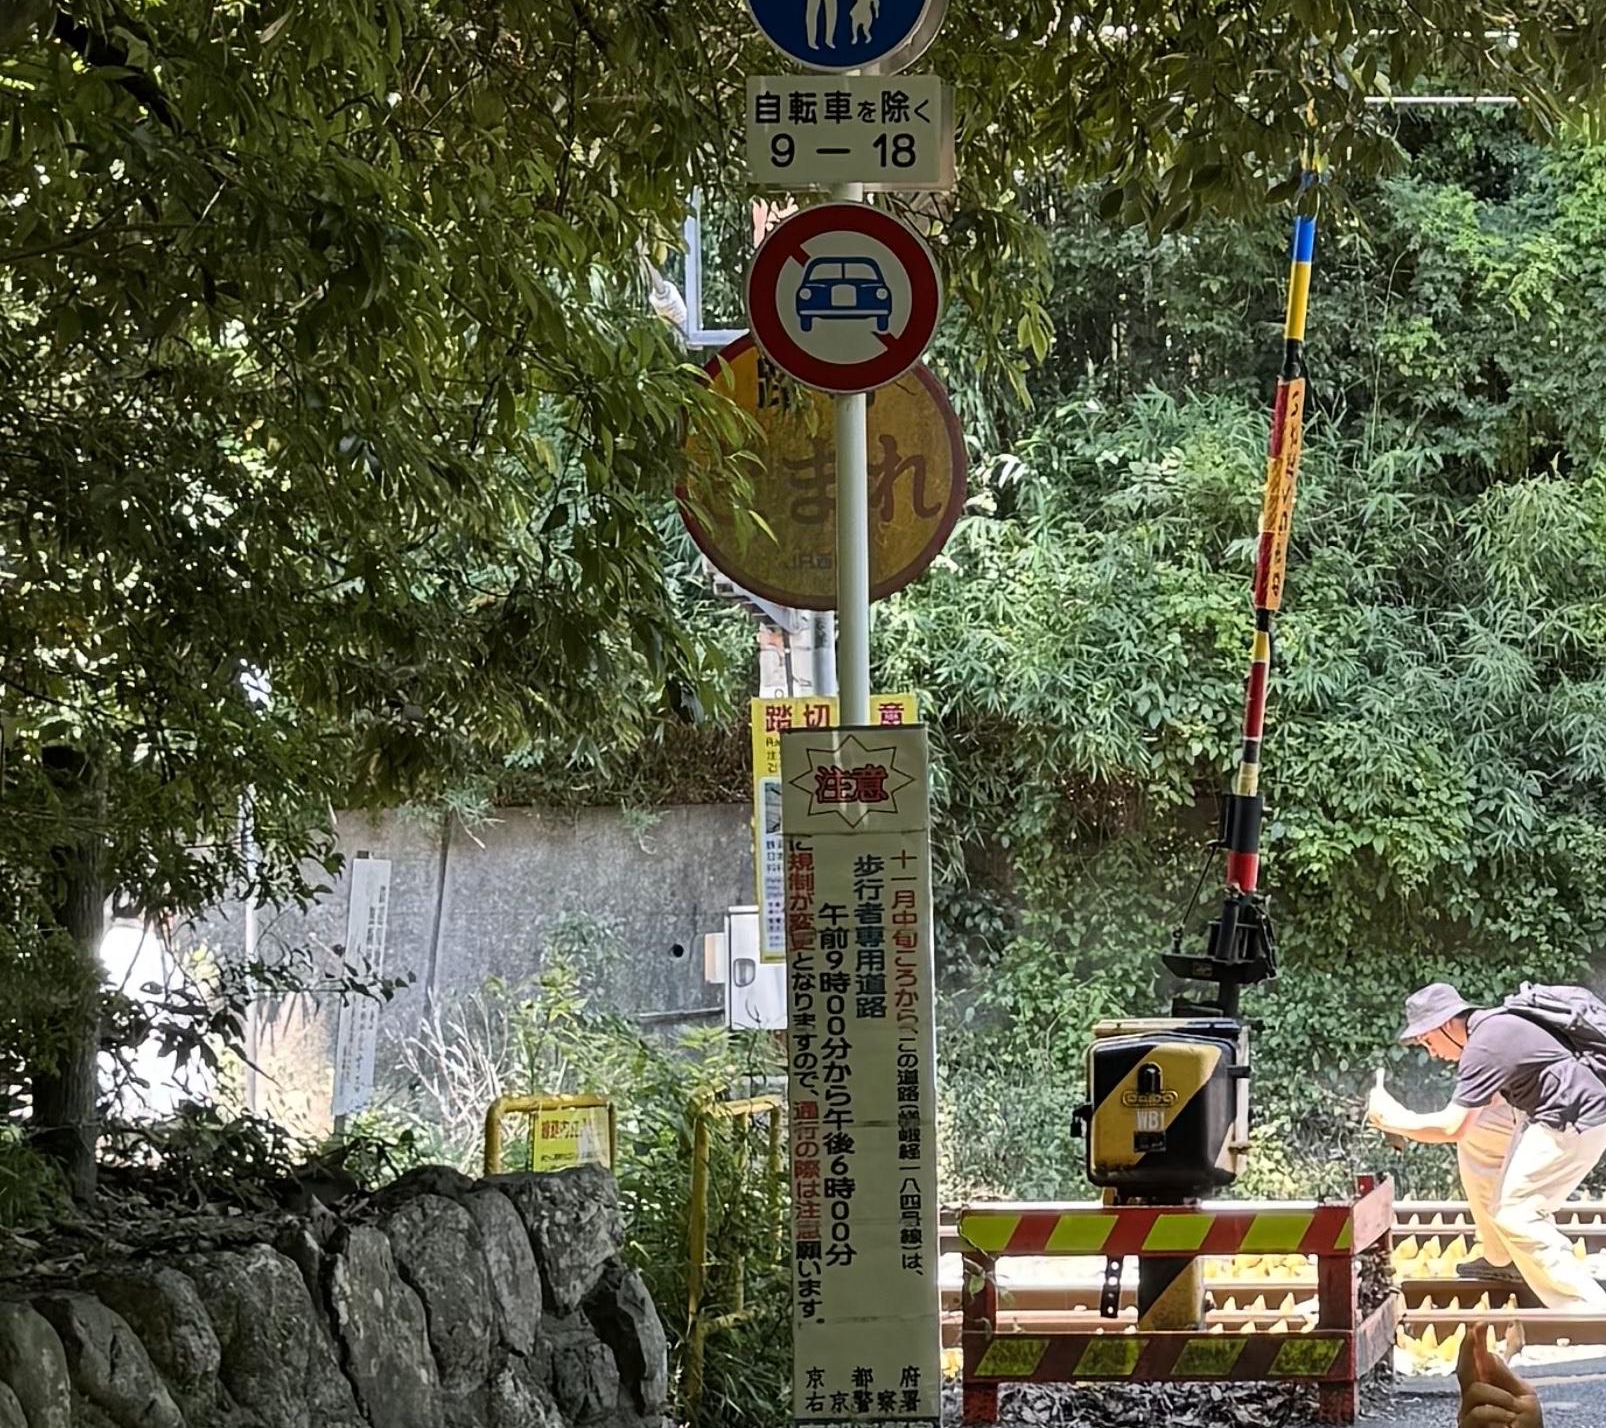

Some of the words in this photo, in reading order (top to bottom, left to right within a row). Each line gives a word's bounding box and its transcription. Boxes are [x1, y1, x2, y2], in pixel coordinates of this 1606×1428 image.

[755, 90, 931, 125] 自転車を除く
[814, 763, 890, 804] 注意
[853, 853, 888, 1019] 歩行者専用道路
[805, 1390, 921, 1414] 右京警察署
